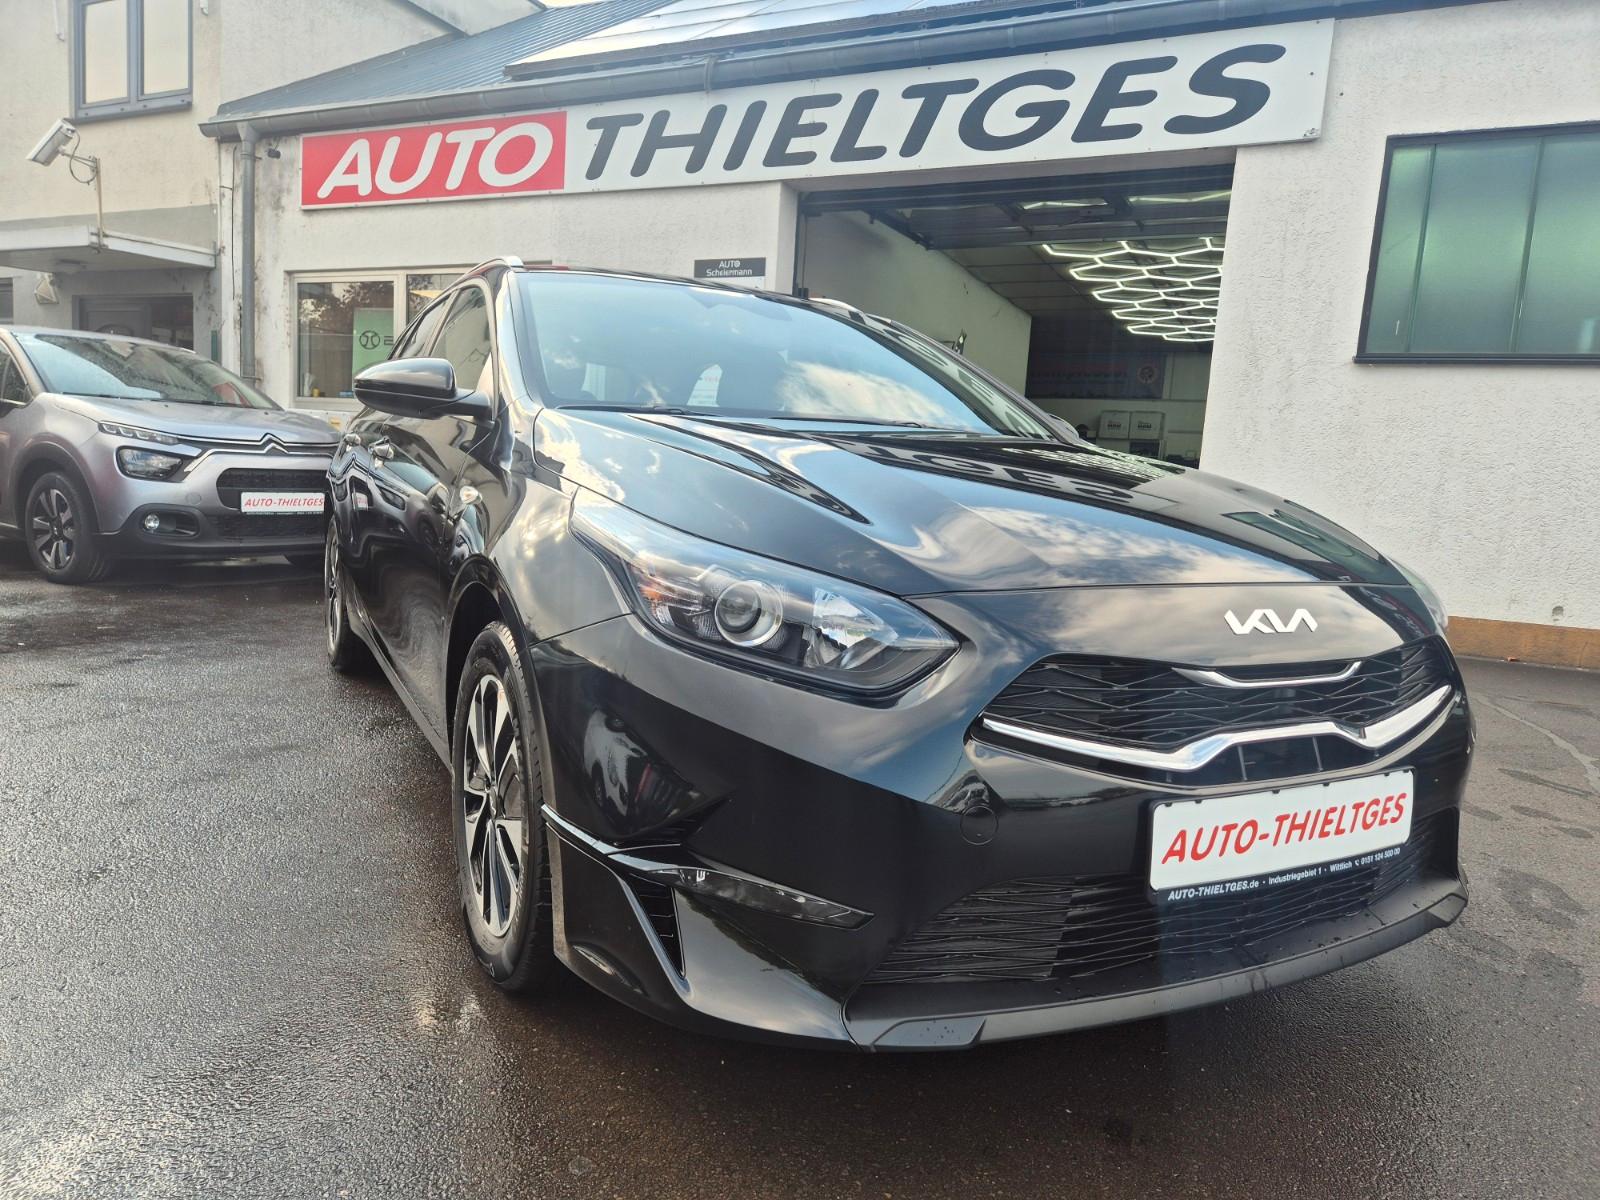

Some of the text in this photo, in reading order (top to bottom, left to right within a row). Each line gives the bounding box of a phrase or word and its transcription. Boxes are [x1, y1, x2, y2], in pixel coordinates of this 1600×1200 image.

[317, 43, 1287, 199] AUTO THIELTGES
[719, 260, 741, 268] AUTO
[244, 498, 324, 507] AUTO-THIELTGES
[1224, 608, 1318, 635] KIA
[1161, 792, 1407, 865] AUTO-THIELTGES
[1168, 880, 1259, 901] AUTO-THIELTGES.de
[1268, 868, 1317, 885] Industriegebiet
